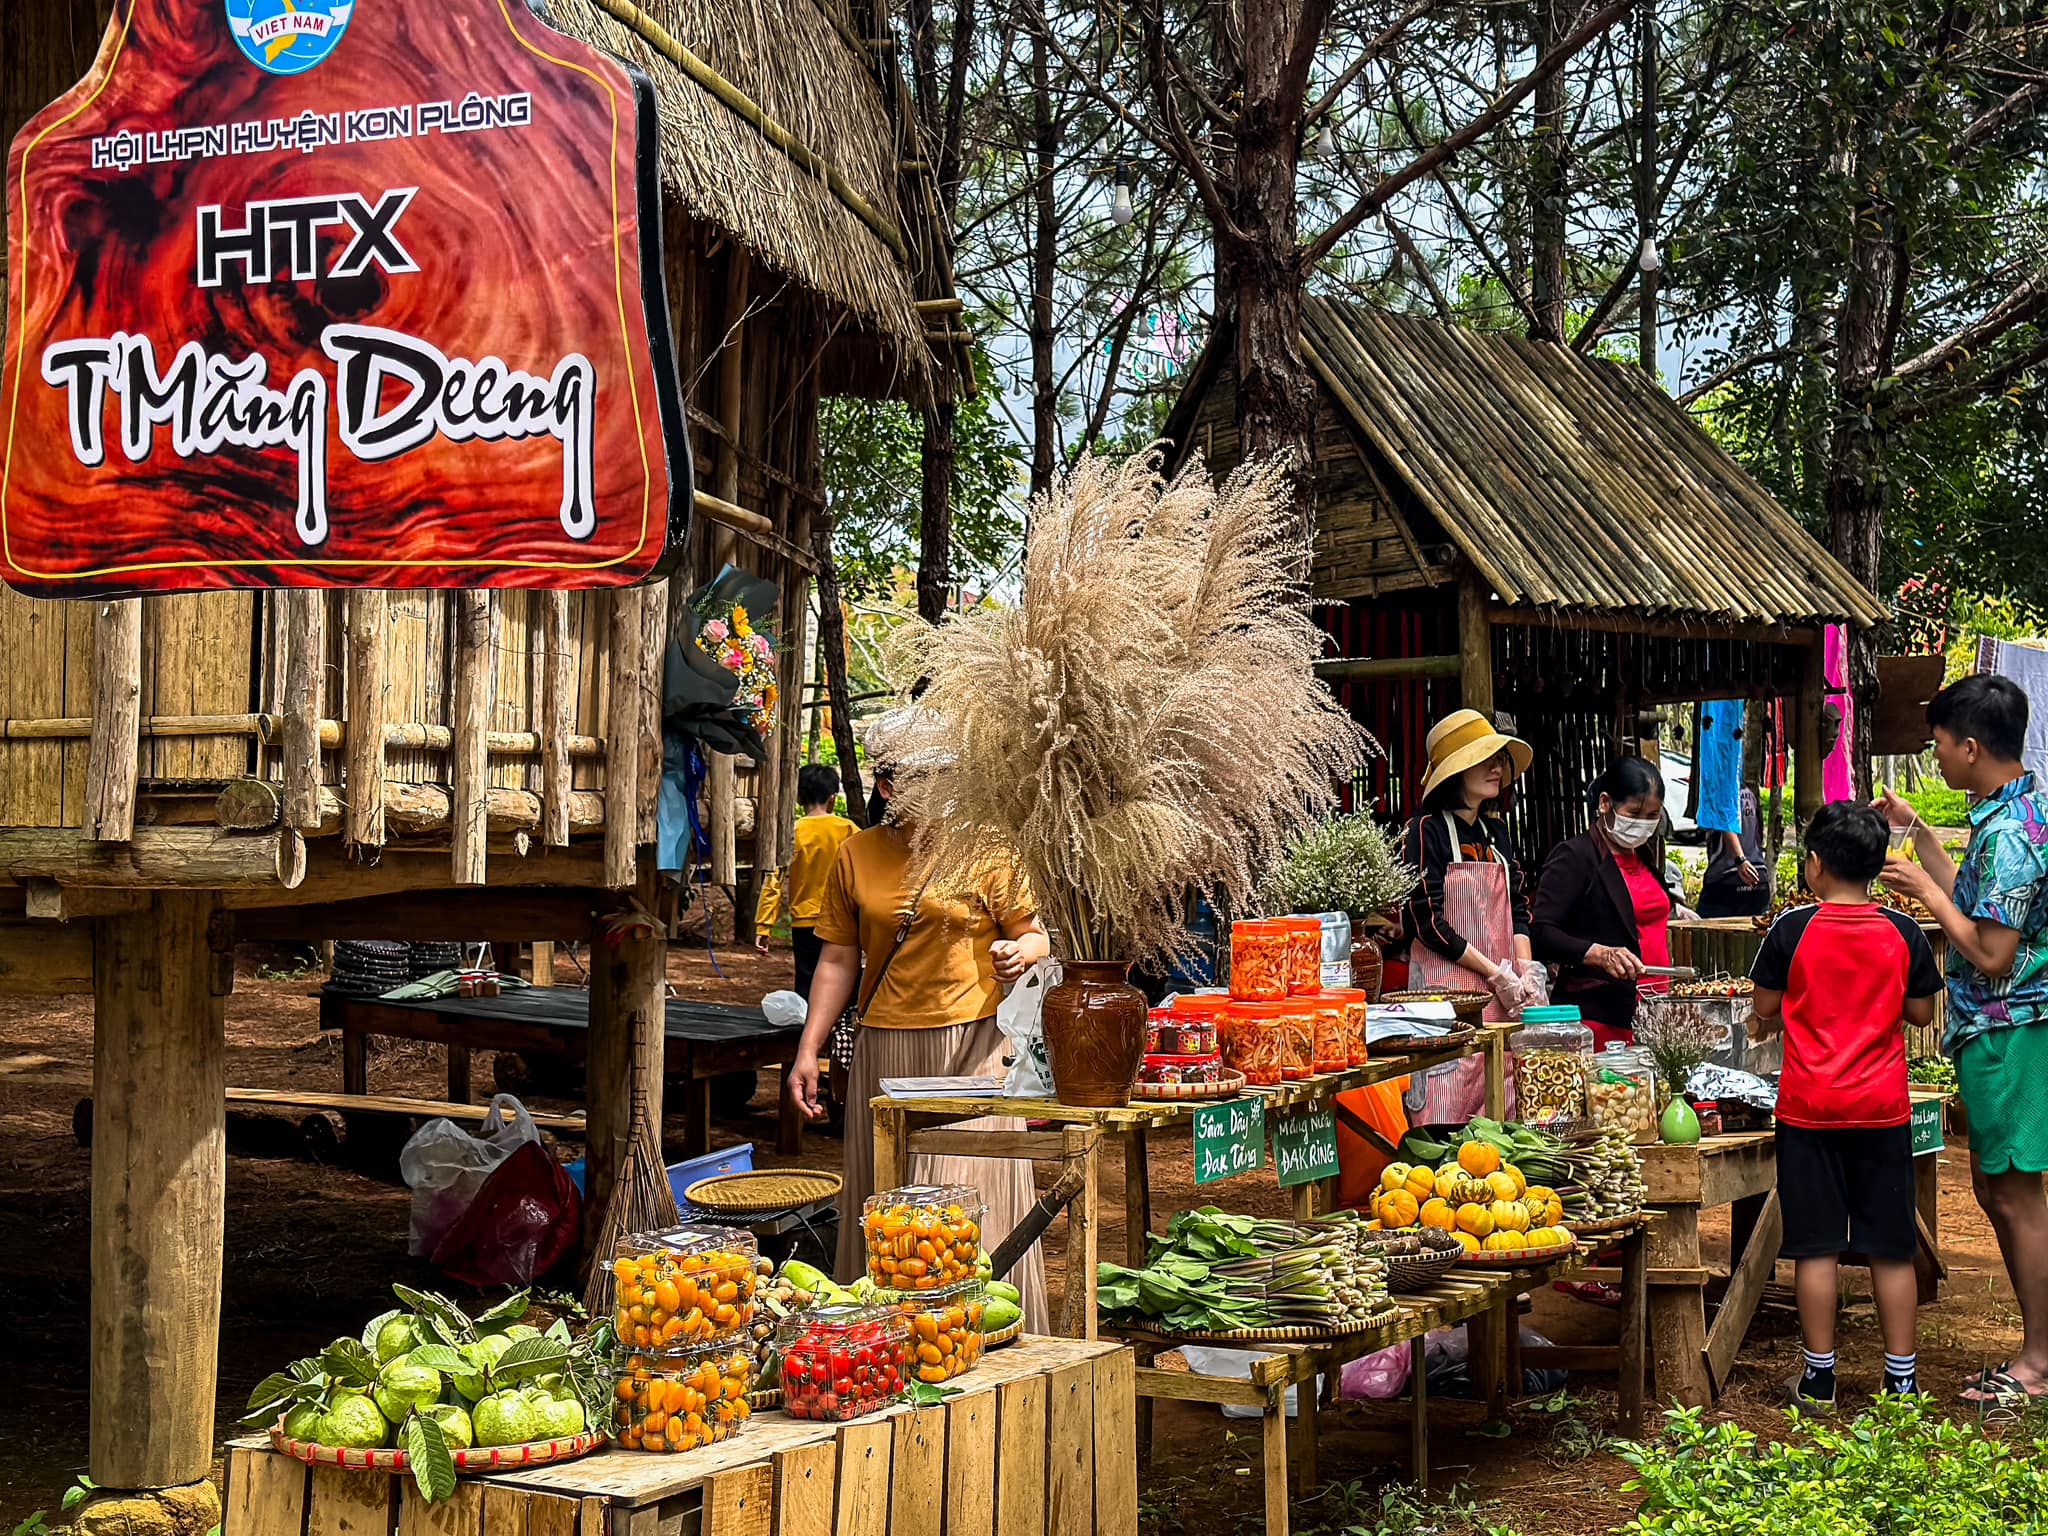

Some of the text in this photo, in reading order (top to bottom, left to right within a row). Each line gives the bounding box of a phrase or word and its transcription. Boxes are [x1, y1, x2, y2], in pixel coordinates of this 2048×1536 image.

[255, 15, 325, 40] VIET NAM
[92, 92, 532, 171] HỘI LHPN HUYỆN KON PLÔNG
[197, 187, 420, 288] HTX
[322, 324, 595, 540] Deeng
[1198, 1107, 1249, 1140] Sâm Dây
